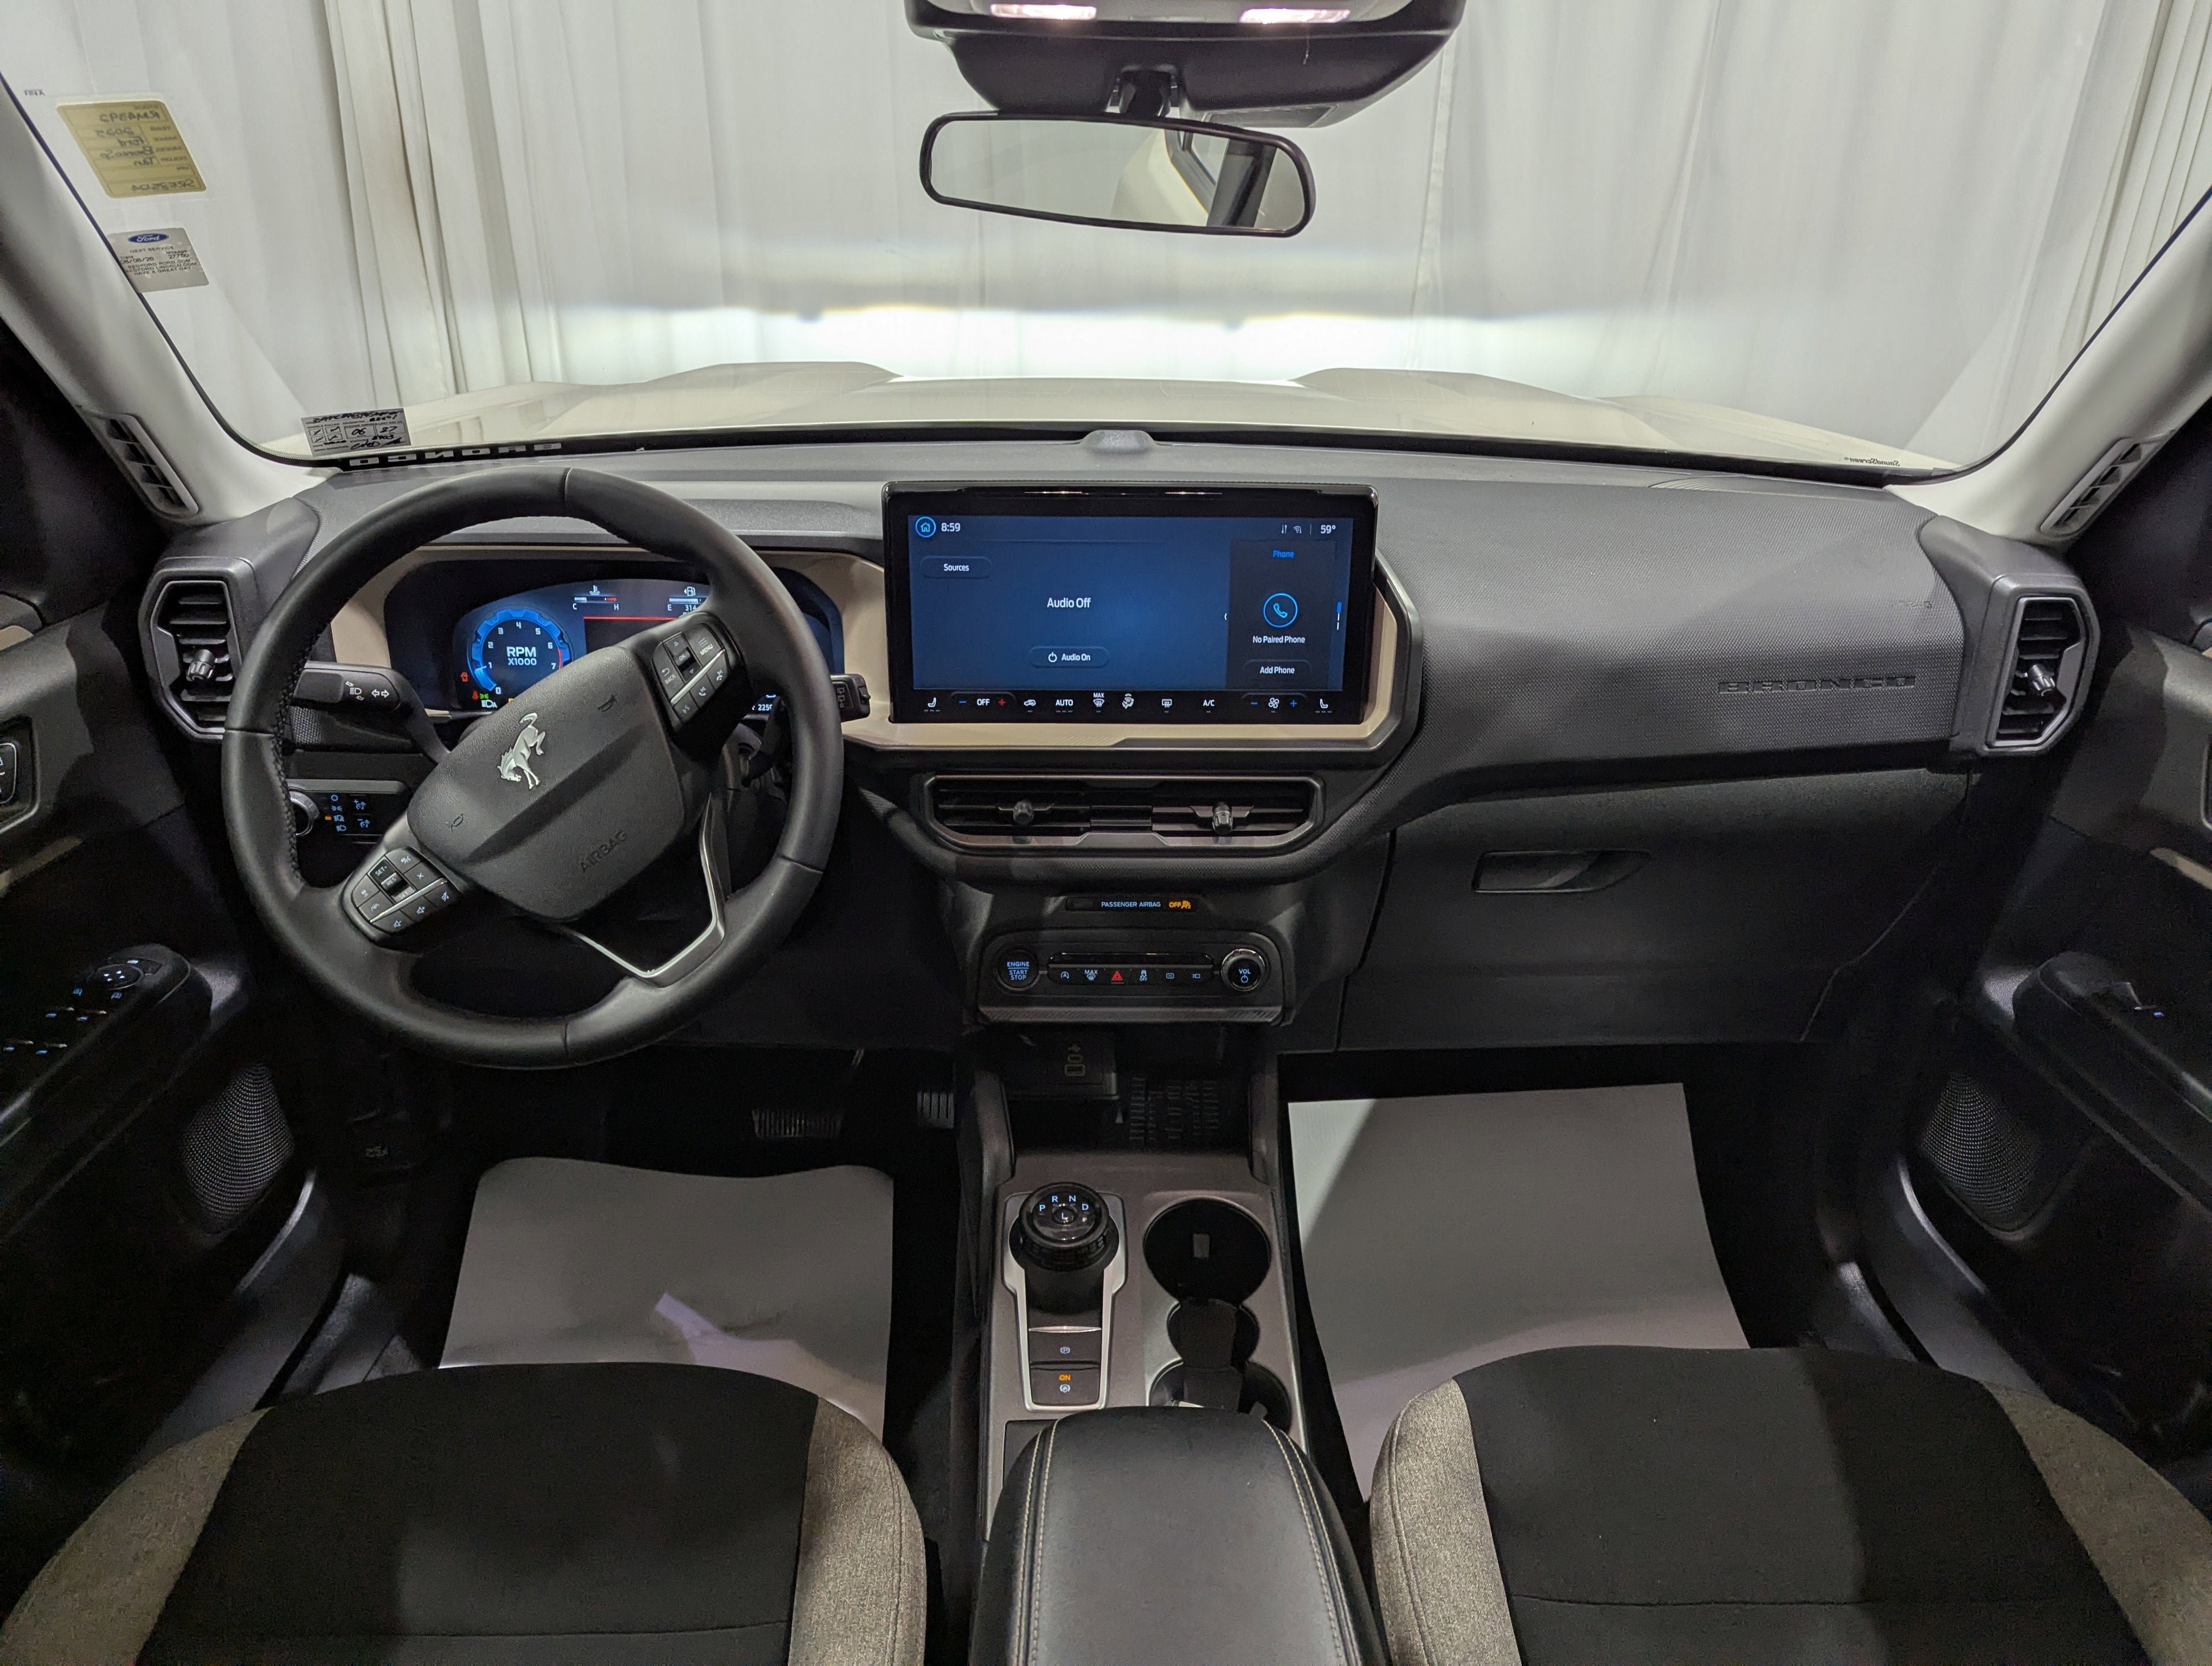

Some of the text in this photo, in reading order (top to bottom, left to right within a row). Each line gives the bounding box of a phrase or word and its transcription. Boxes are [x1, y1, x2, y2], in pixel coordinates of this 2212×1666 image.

[941, 523, 961, 532] 8:59
[1320, 524, 1336, 534] 59°
[1273, 550, 1295, 558] Phone
[943, 563, 969, 572] Sources
[1047, 597, 1091, 608] Audio Off
[1263, 636, 1283, 644] Paired
[1284, 636, 1306, 644] Phone
[506, 646, 537, 657] RPM
[700, 644, 713, 656] MENU
[507, 658, 537, 666] X1000
[664, 674, 677, 684] BACK
[1719, 677, 1915, 694] BRONCO
[977, 698, 990, 706] OFF
[581, 830, 626, 873] AIRBAG
[386, 877, 397, 886] RES
